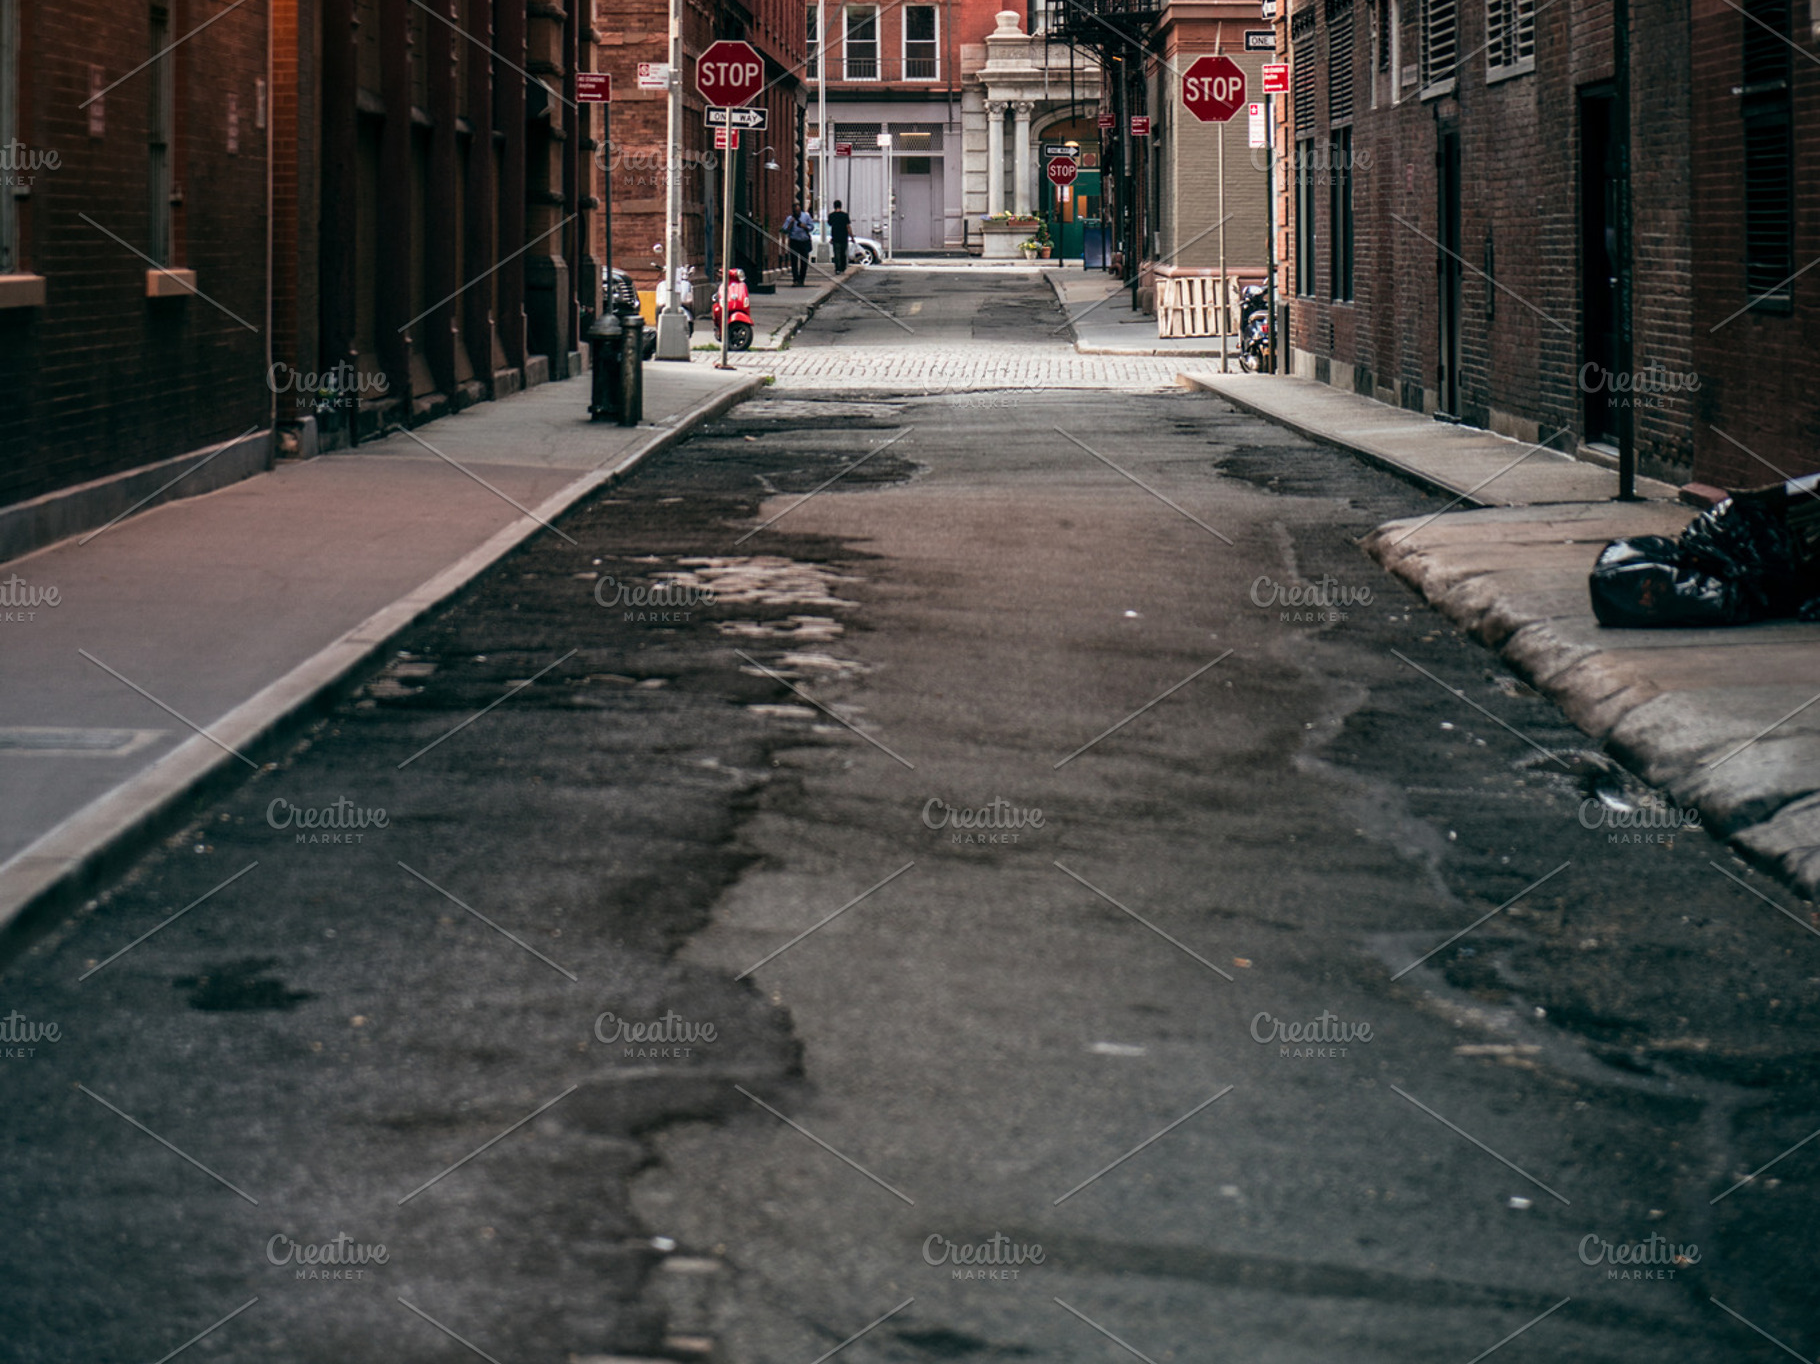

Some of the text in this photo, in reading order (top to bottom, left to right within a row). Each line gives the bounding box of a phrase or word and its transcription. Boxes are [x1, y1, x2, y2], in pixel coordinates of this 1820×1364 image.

[1251, 37, 1269, 45] ONE
[701, 61, 759, 87] STOP
[1186, 76, 1242, 102] STOP
[714, 112, 758, 123] ON WAY
[1050, 165, 1076, 177] STOP
